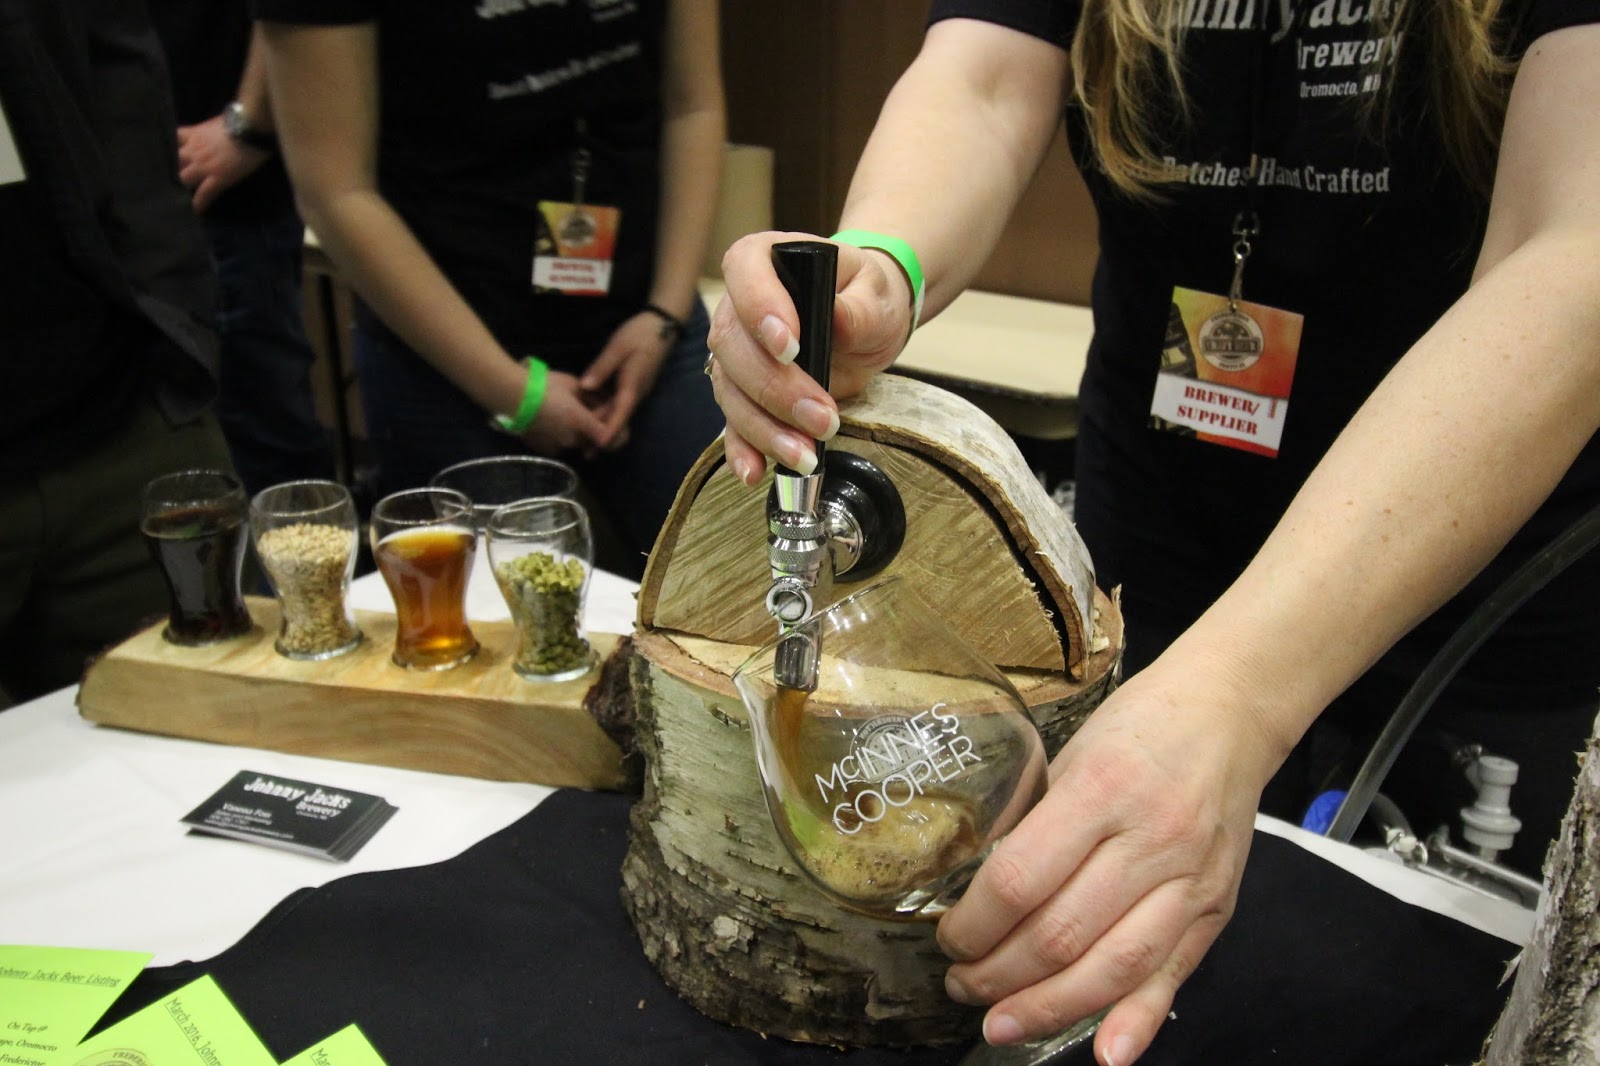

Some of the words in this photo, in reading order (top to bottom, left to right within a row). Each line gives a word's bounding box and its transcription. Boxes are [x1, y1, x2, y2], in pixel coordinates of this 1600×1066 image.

[1257, 157, 1301, 189] Hand
[1304, 165, 1390, 193] Crafted
[1184, 386, 1260, 415] BREWER/
[1177, 405, 1258, 435] SUPPLIER
[243, 778, 305, 801] Johnny
[833, 735, 982, 835] COOPER
[296, 801, 341, 818] Brewery
[60, 972, 85, 984] Beer
[86, 974, 120, 988] Listing
[7, 1021, 20, 1031] On
[22, 1022, 37, 1034] Tap
[165, 997, 191, 1025] March
[183, 1022, 203, 1046] 2016,
